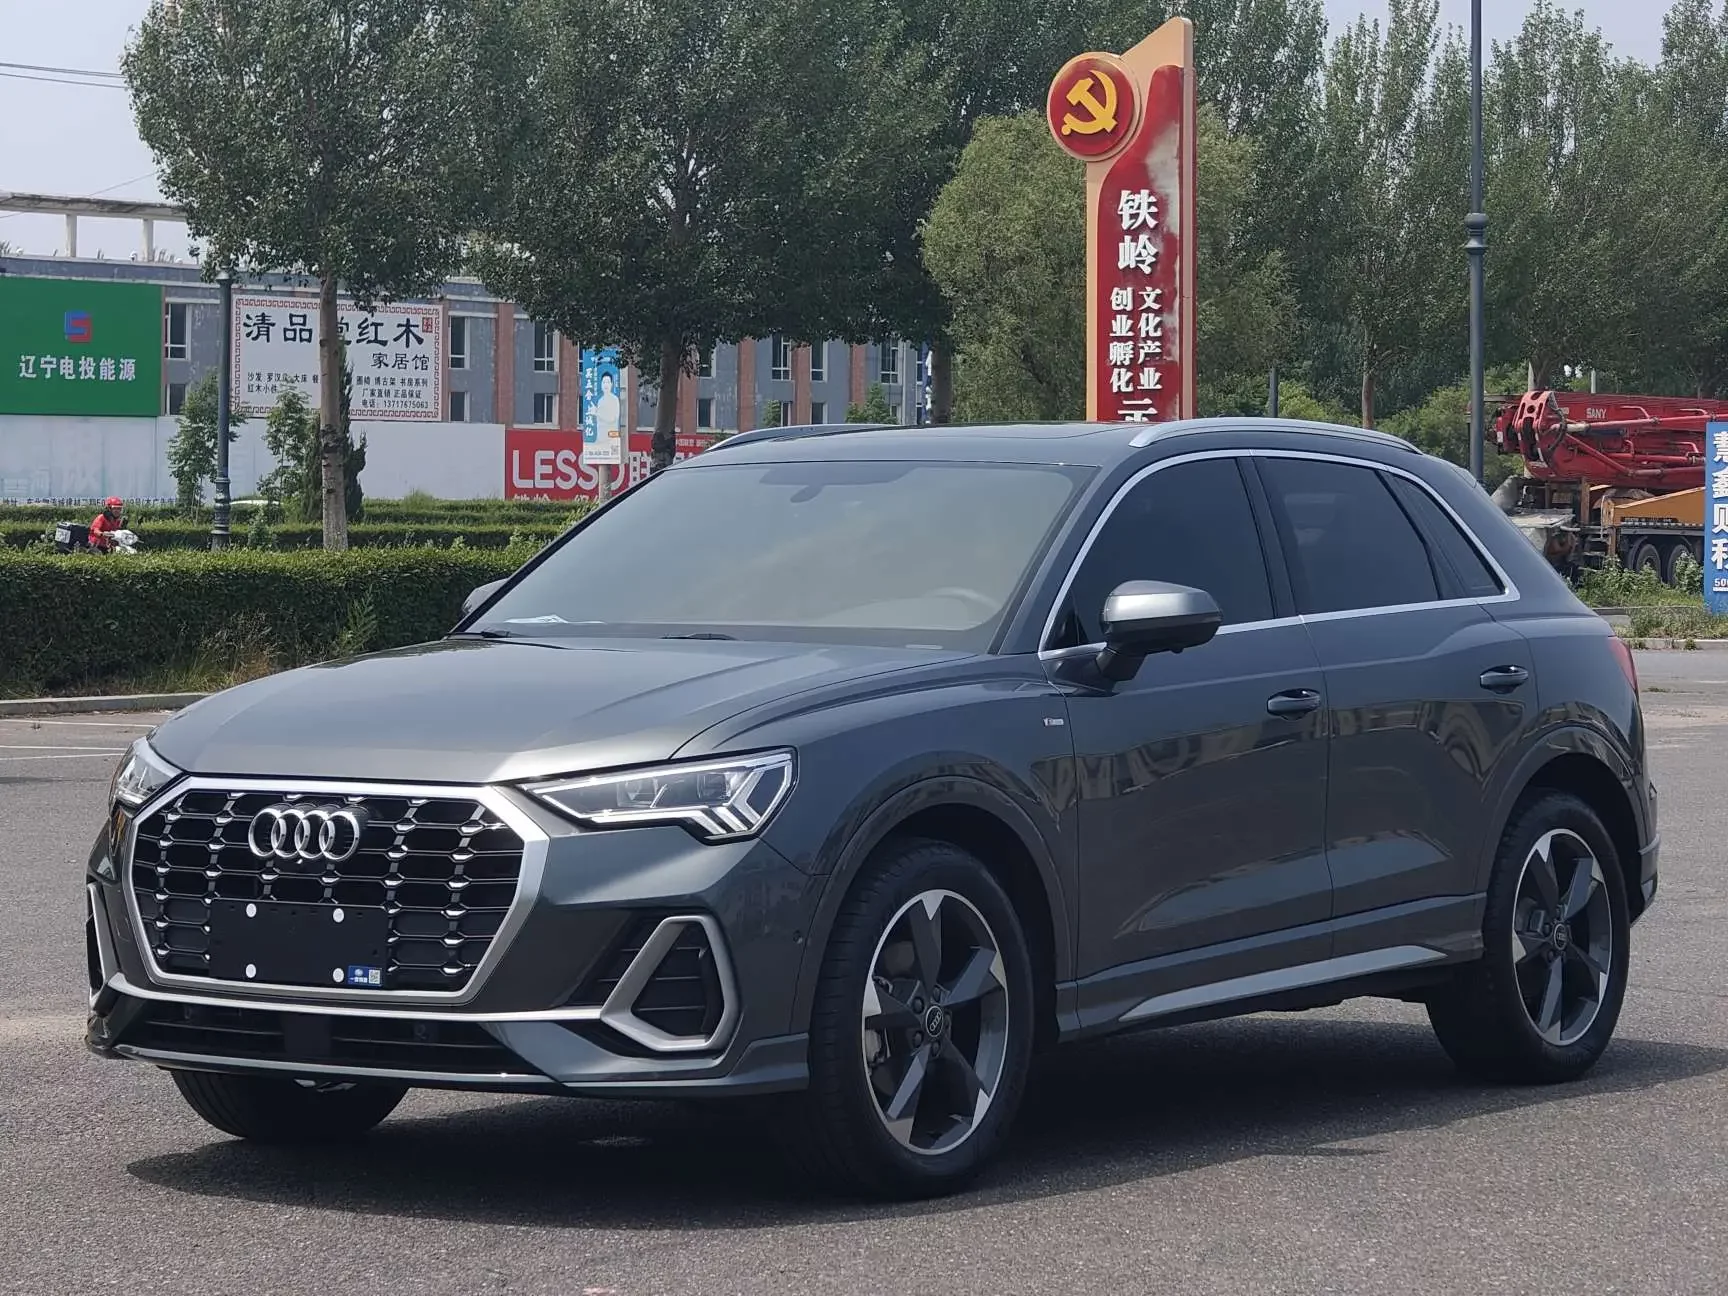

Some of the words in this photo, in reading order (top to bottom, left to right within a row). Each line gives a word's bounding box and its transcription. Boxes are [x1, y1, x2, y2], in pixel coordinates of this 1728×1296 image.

[1117, 189, 1160, 275] 铁岭
[1109, 286, 1135, 394] 创业孵化
[1136, 286, 1163, 391] 文化产业
[19, 354, 137, 382] 辽宁电投能源
[370, 352, 430, 371] 家居馆
[362, 387, 391, 399] 厂家直销
[393, 388, 422, 399] 正品保证
[1586, 407, 1607, 419] SANY
